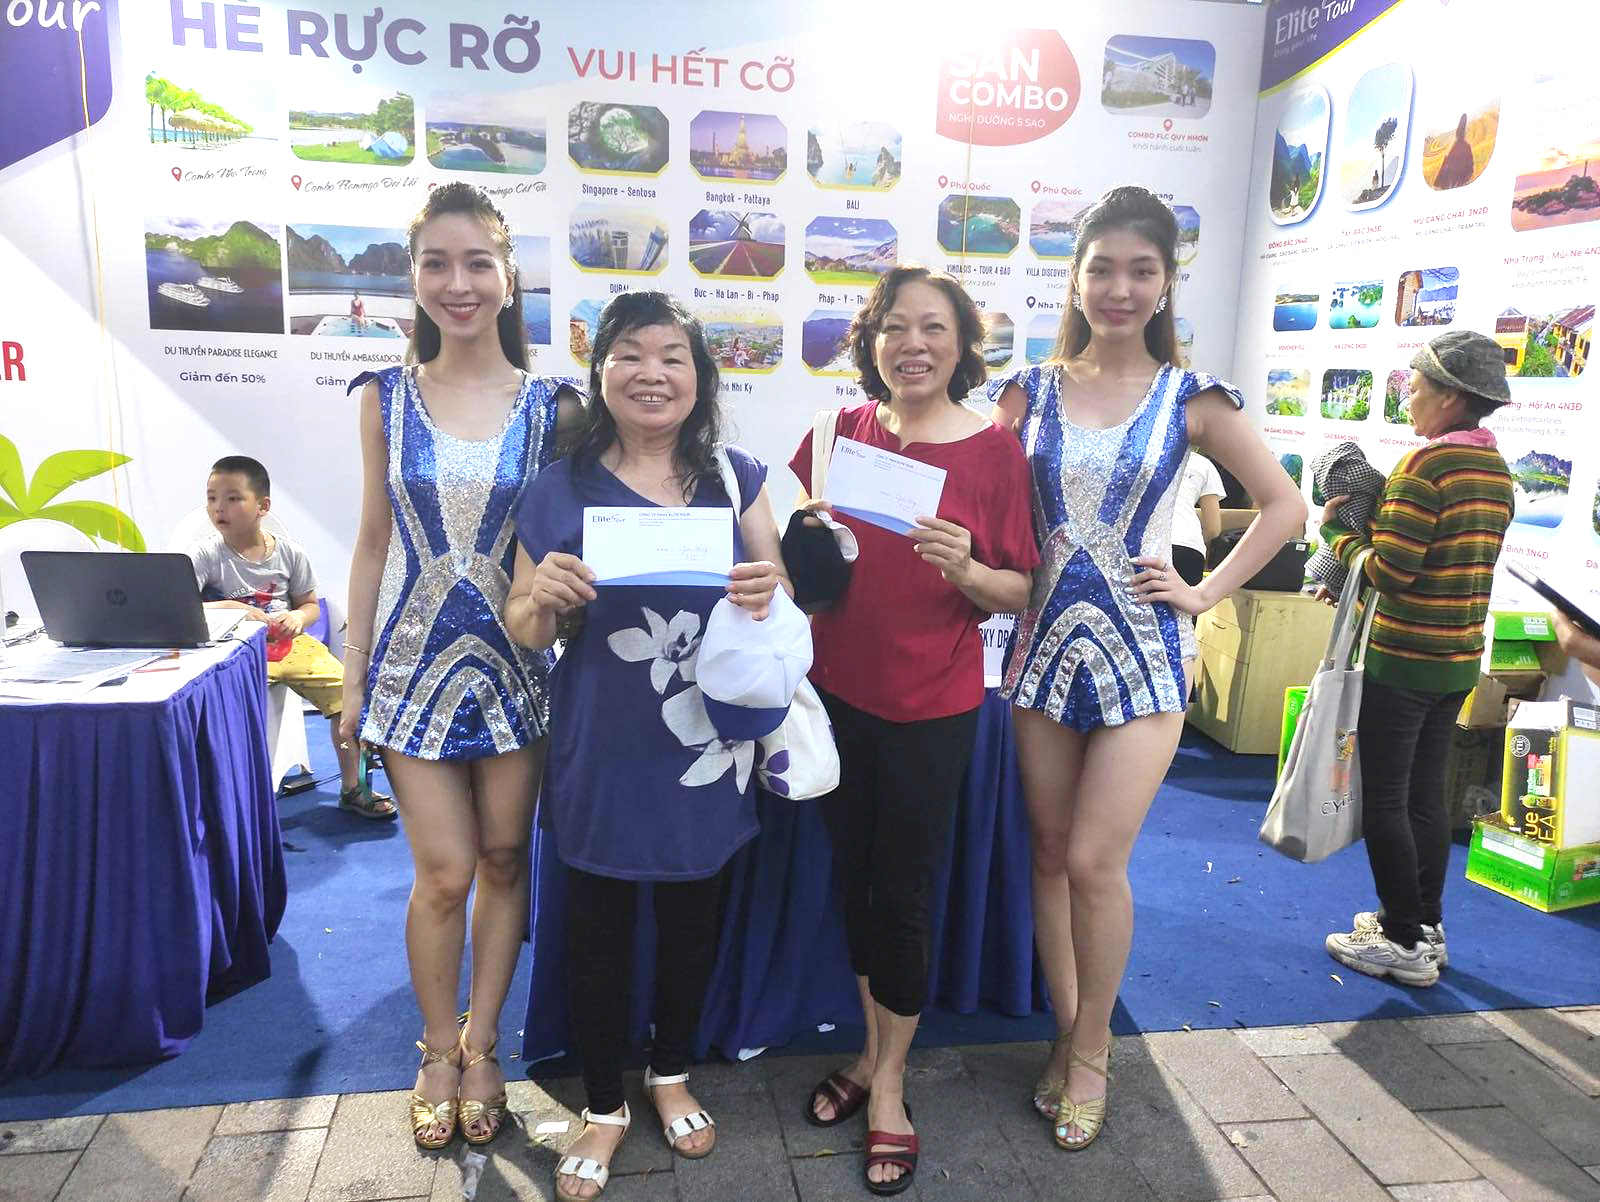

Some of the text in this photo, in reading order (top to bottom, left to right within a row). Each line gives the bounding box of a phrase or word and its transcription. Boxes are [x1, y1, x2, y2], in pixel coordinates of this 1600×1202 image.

[1274, 6, 1320, 45] Elite
[287, 7, 428, 74] RỰC
[447, 14, 542, 73] RỠ
[567, 47, 795, 92] VUI HẾT CỠ
[949, 79, 1069, 112] COMBO
[184, 170, 215, 182] Combo
[304, 181, 335, 193] Combo
[582, 184, 618, 197] Singapore
[627, 186, 656, 198] Sentosa
[705, 192, 735, 204] Bangkok
[744, 193, 771, 207] Pattaya
[846, 200, 860, 210] BALI
[164, 346, 177, 355] DU
[208, 347, 242, 358] PARADISE
[244, 348, 278, 359] ELEGANCE
[310, 351, 322, 361] DU
[352, 352, 402, 364] AMBASSADOR
[215, 370, 238, 383] đến
[241, 373, 266, 384] 50%
[1544, 401, 1556, 410] An
[592, 514, 611, 523] Elite
